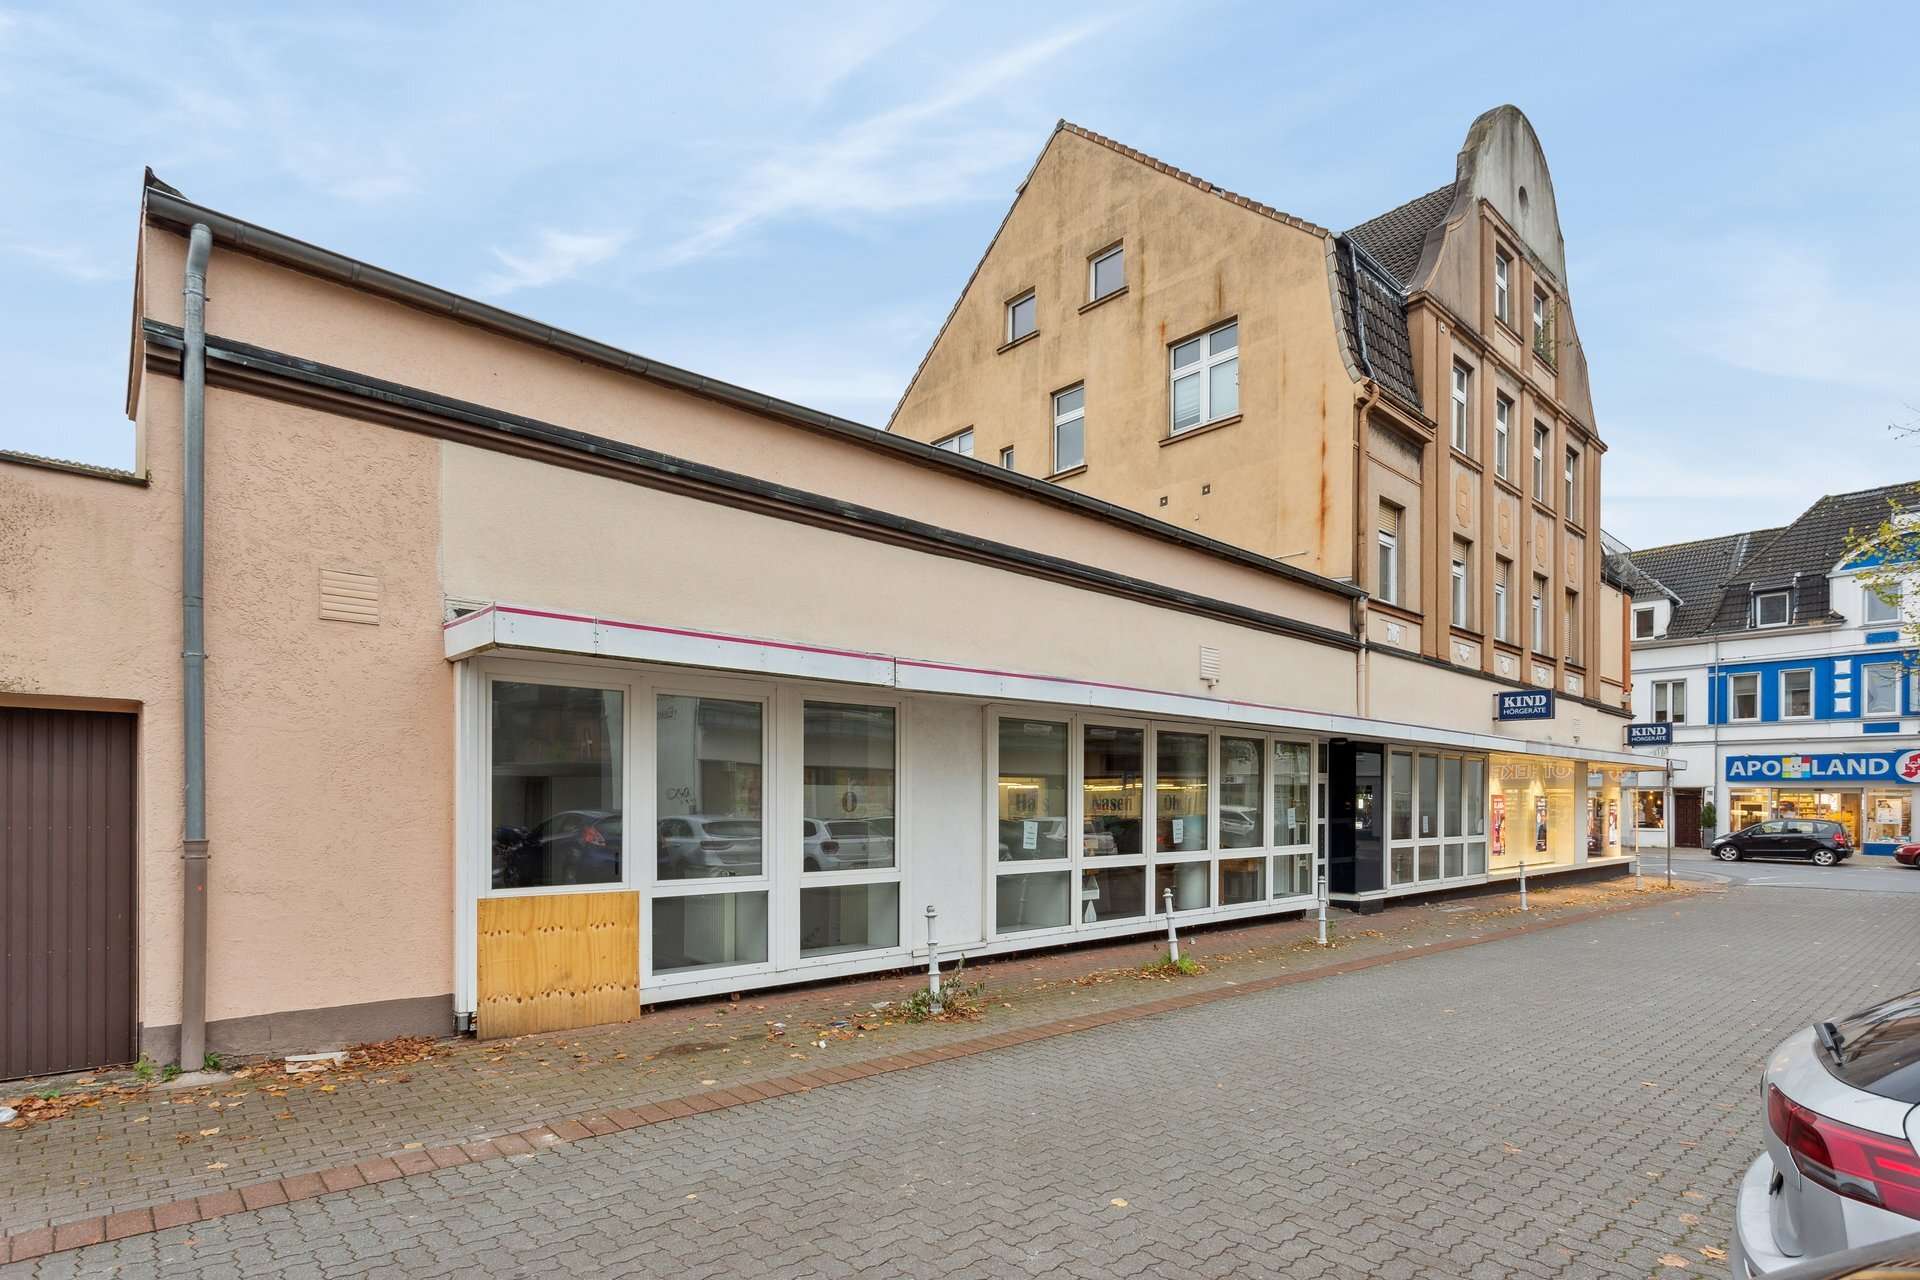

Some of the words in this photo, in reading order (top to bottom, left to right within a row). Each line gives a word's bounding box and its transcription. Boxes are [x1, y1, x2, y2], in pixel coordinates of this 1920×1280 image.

[1503, 694, 1547, 708] KIND
[1631, 726, 1667, 736] KIND
[1729, 760, 1782, 777] APO
[1811, 758, 1890, 776] LAND
